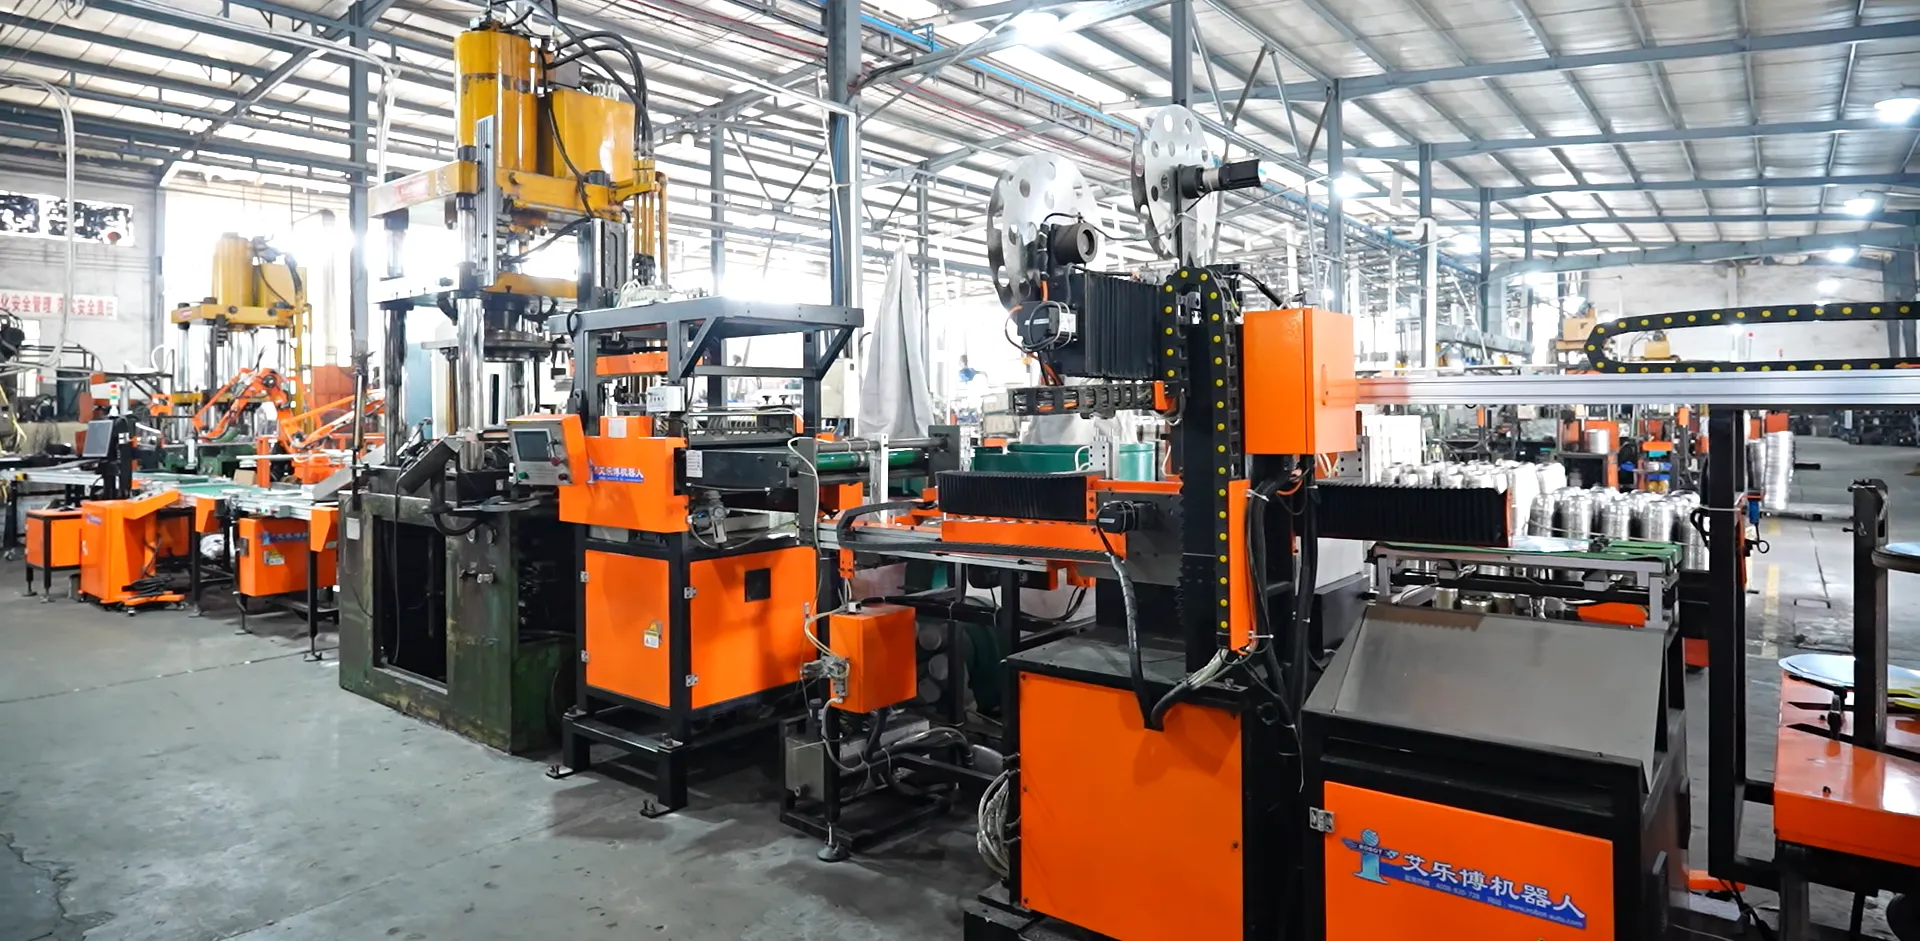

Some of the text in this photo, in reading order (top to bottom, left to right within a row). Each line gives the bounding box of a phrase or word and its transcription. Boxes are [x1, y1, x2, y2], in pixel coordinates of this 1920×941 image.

[1403, 854, 1585, 919] 艾乐博机器人
